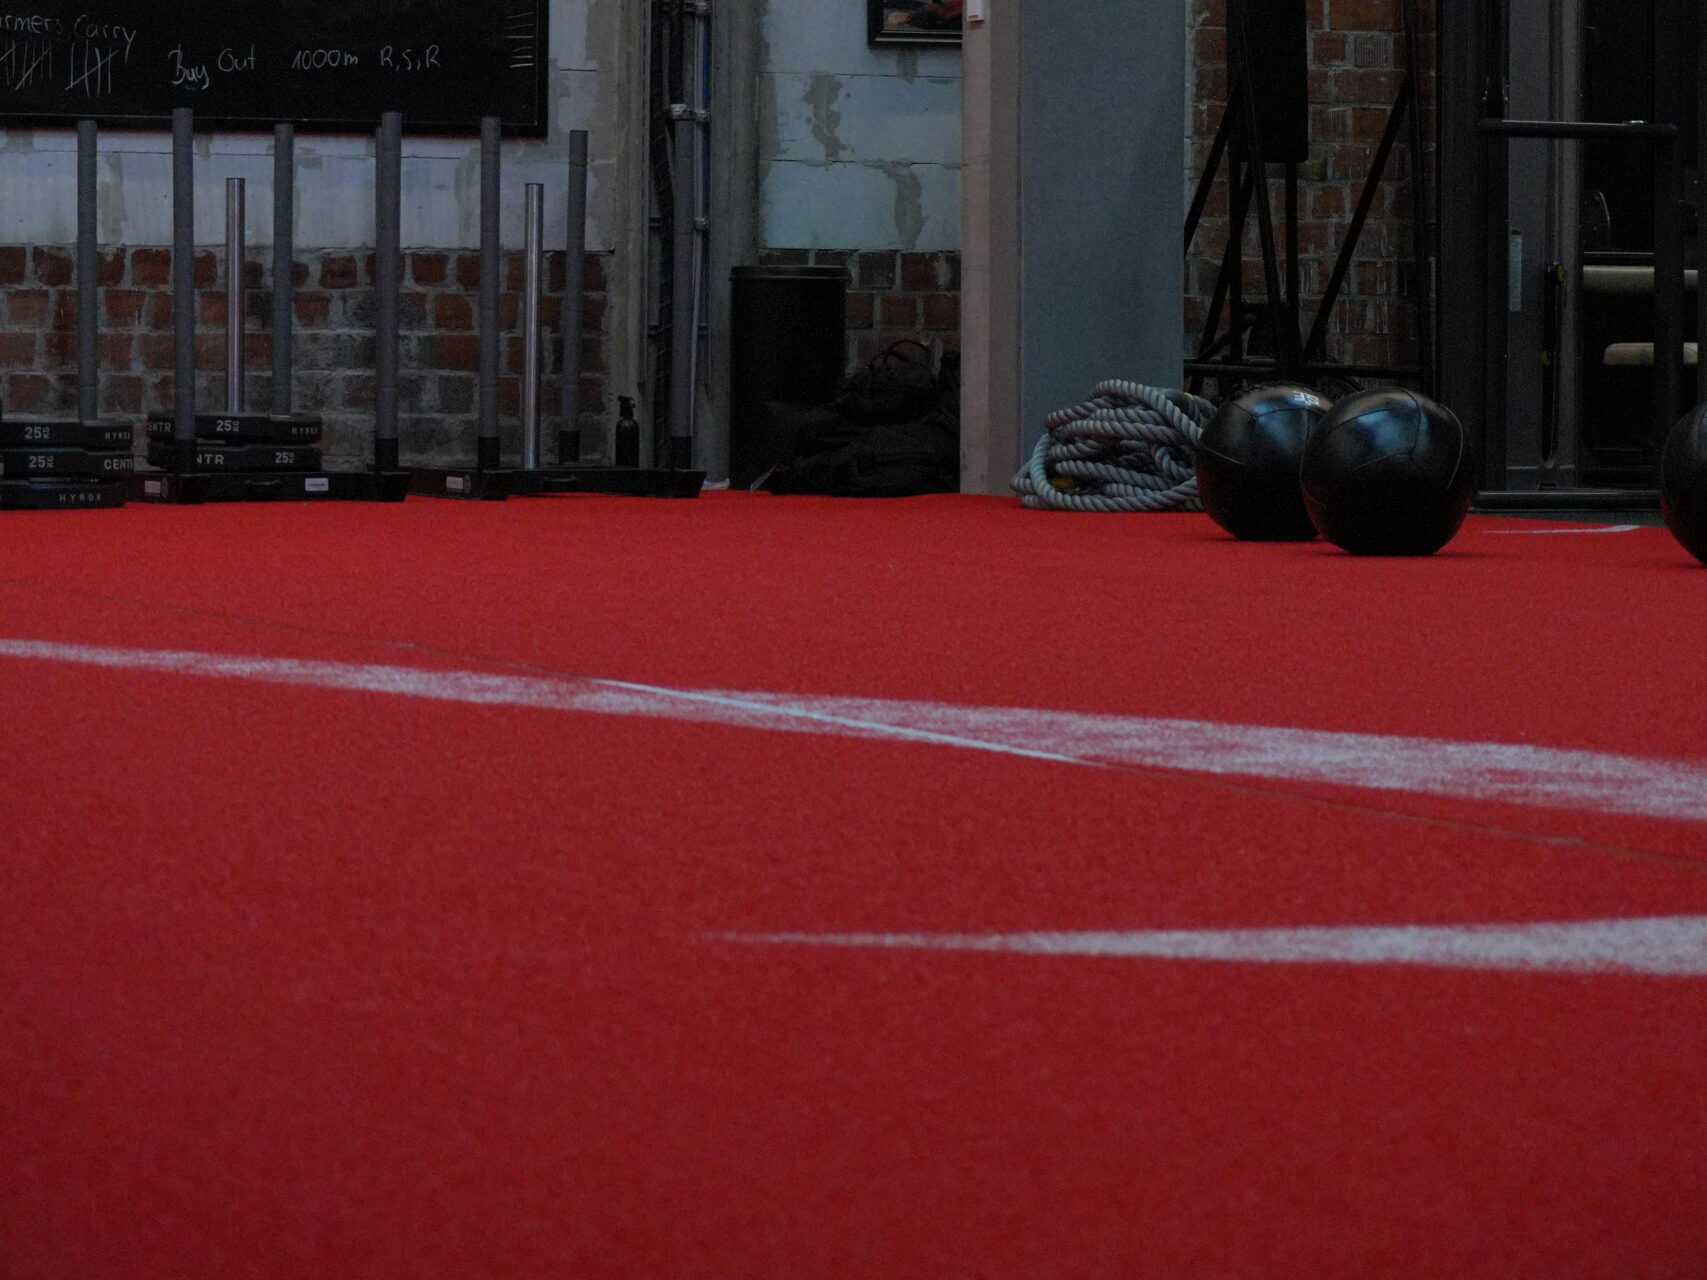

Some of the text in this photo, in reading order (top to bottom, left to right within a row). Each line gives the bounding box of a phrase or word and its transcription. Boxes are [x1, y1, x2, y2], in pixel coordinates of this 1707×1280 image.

[74, 13, 137, 65] Carry
[168, 43, 210, 90] Buy
[217, 44, 256, 72] Out
[291, 49, 359, 70] 1000m
[216, 419, 231, 432] 25
[24, 426, 43, 439] 25
[28, 455, 46, 468] 25
[274, 451, 289, 464] 25
